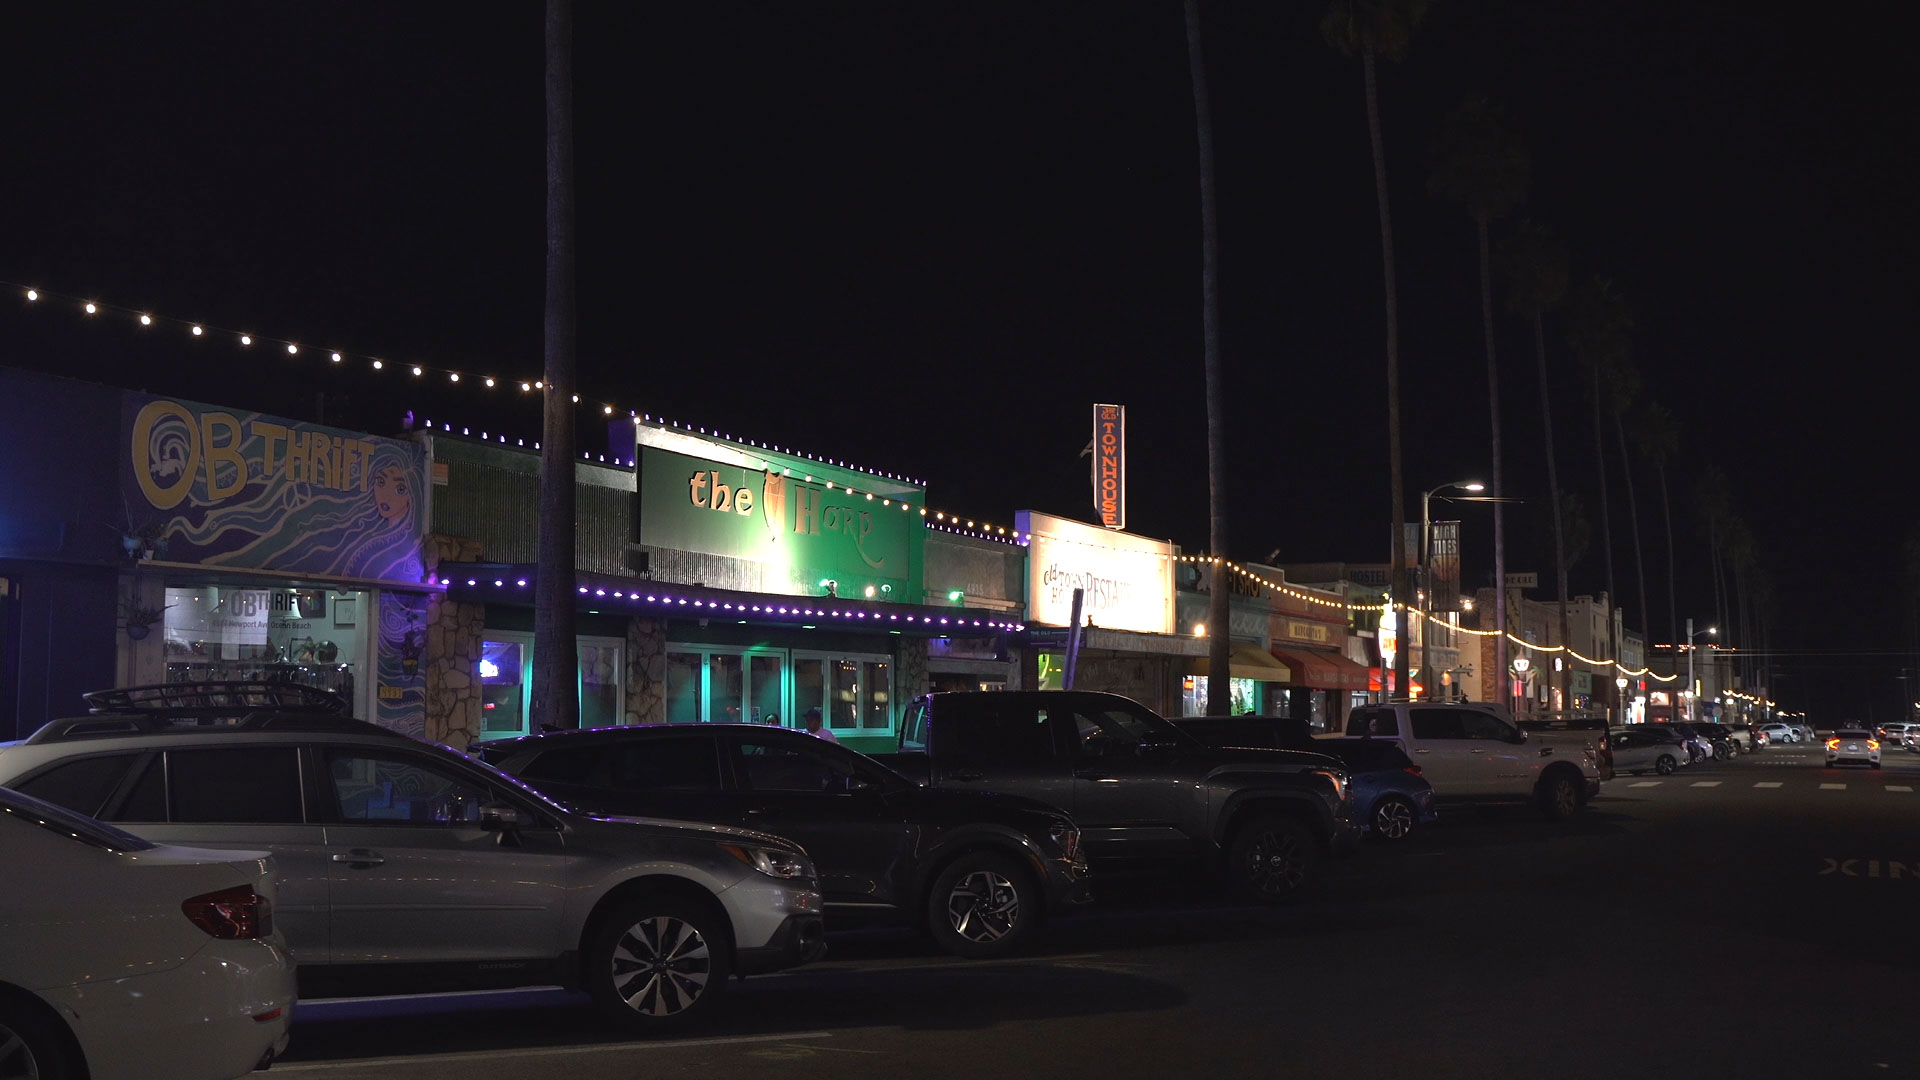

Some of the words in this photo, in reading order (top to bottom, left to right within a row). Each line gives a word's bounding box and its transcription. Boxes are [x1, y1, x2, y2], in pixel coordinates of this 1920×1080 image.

[131, 400, 248, 510] OB
[1102, 422, 1117, 525] TOWNHOUSE
[689, 470, 754, 517] the
[1350, 569, 1388, 584] HOSTEL
[271, 621, 291, 630] Ocean
[292, 621, 312, 630] Beach
